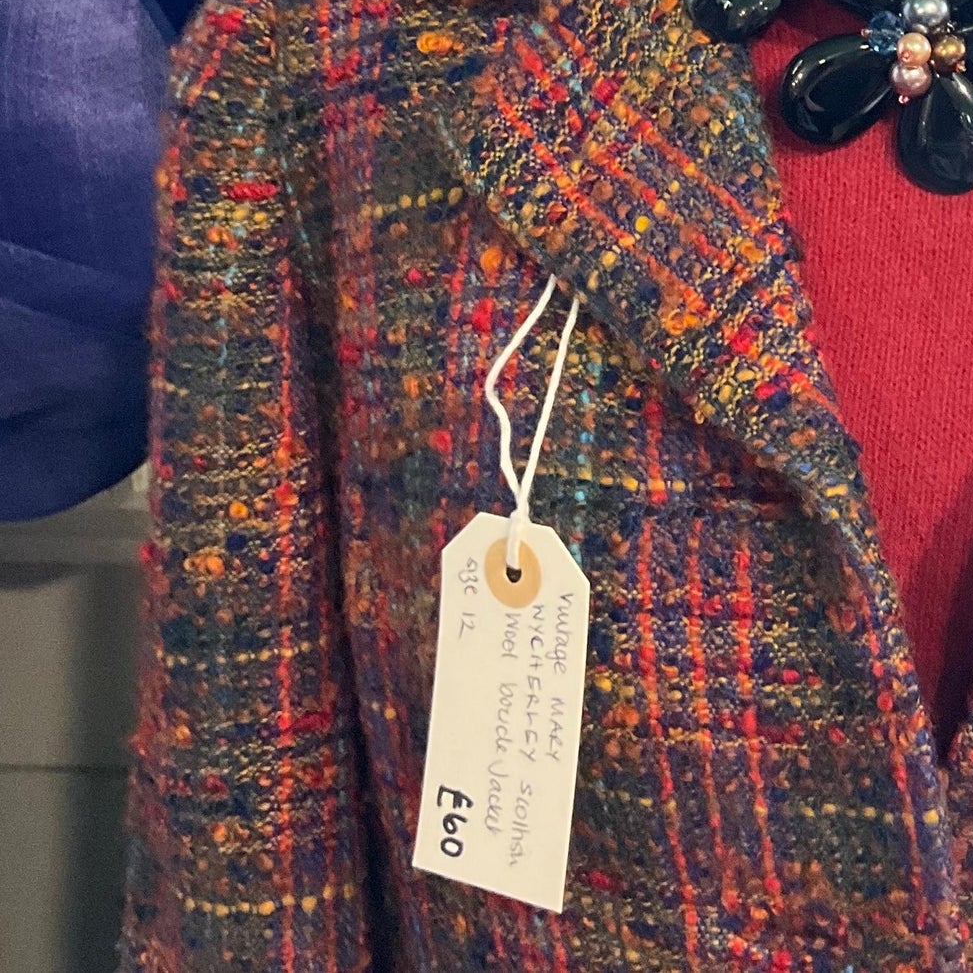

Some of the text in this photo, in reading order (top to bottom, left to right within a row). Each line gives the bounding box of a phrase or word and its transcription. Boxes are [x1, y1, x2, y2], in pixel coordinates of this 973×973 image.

[458, 611, 477, 640] 12
[520, 604, 546, 763] WYCHERLEY
[546, 696, 568, 762] MARY
[436, 784, 475, 858] £60
